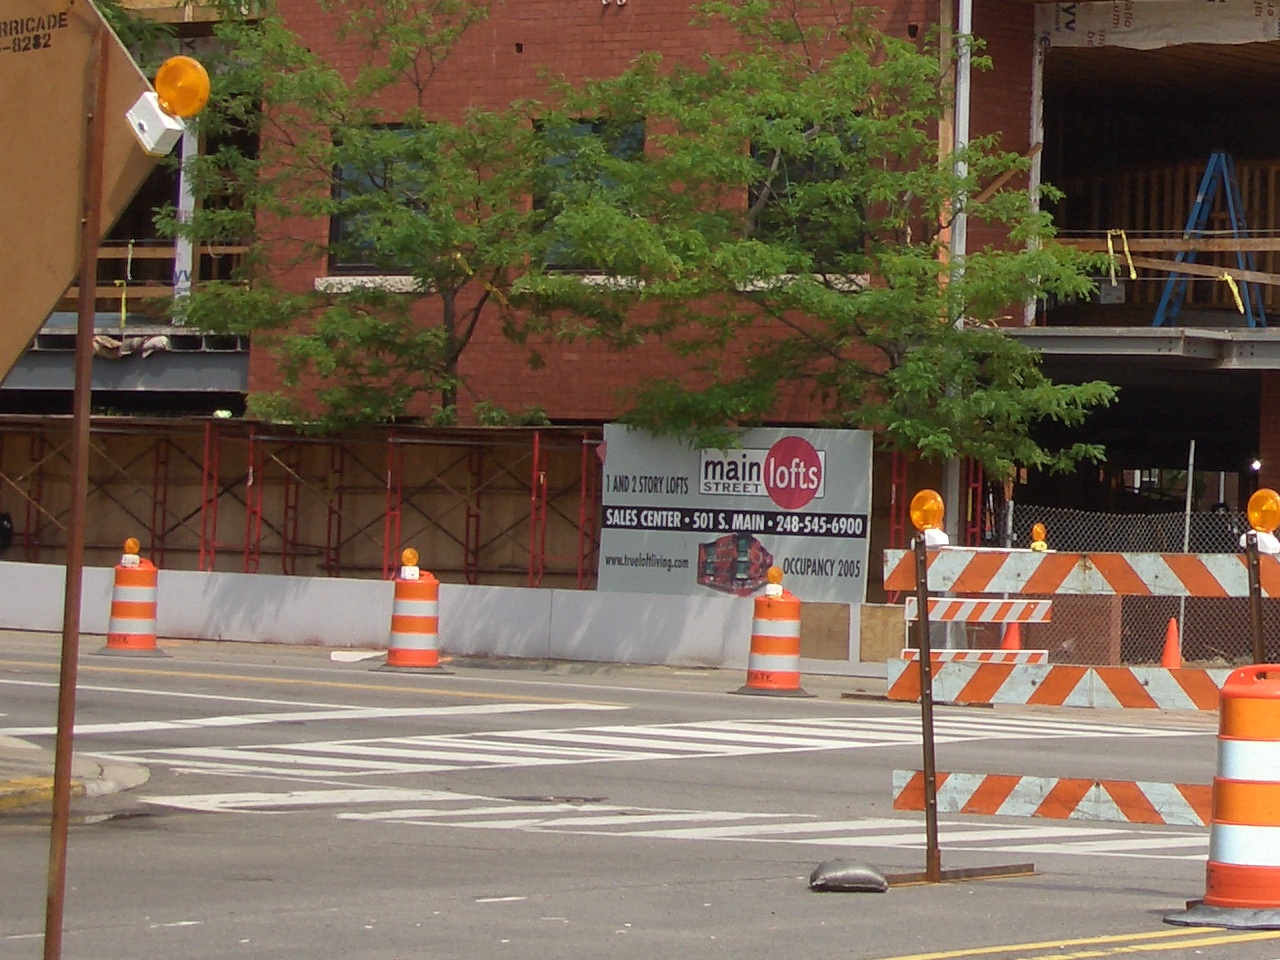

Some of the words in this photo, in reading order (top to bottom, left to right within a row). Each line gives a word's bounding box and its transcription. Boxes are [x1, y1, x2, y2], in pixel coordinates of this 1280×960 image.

[0, 11, 68, 37] RRICADE
[704, 454, 762, 482] main
[768, 456, 819, 490] lofts
[612, 475, 630, 493] AND
[632, 476, 638, 493] 2
[639, 476, 664, 495] STORY
[665, 476, 689, 496] LOFTS
[703, 481, 762, 494] STREET
[606, 508, 638, 527] SALES
[640, 509, 681, 528] CENTER
[692, 513, 714, 530] 501
[717, 515, 729, 530] S.
[732, 515, 765, 532] MAIN
[776, 516, 864, 535] 248-545-6900
[783, 557, 836, 577] OCCUPANCY
[838, 559, 862, 578] 2005
